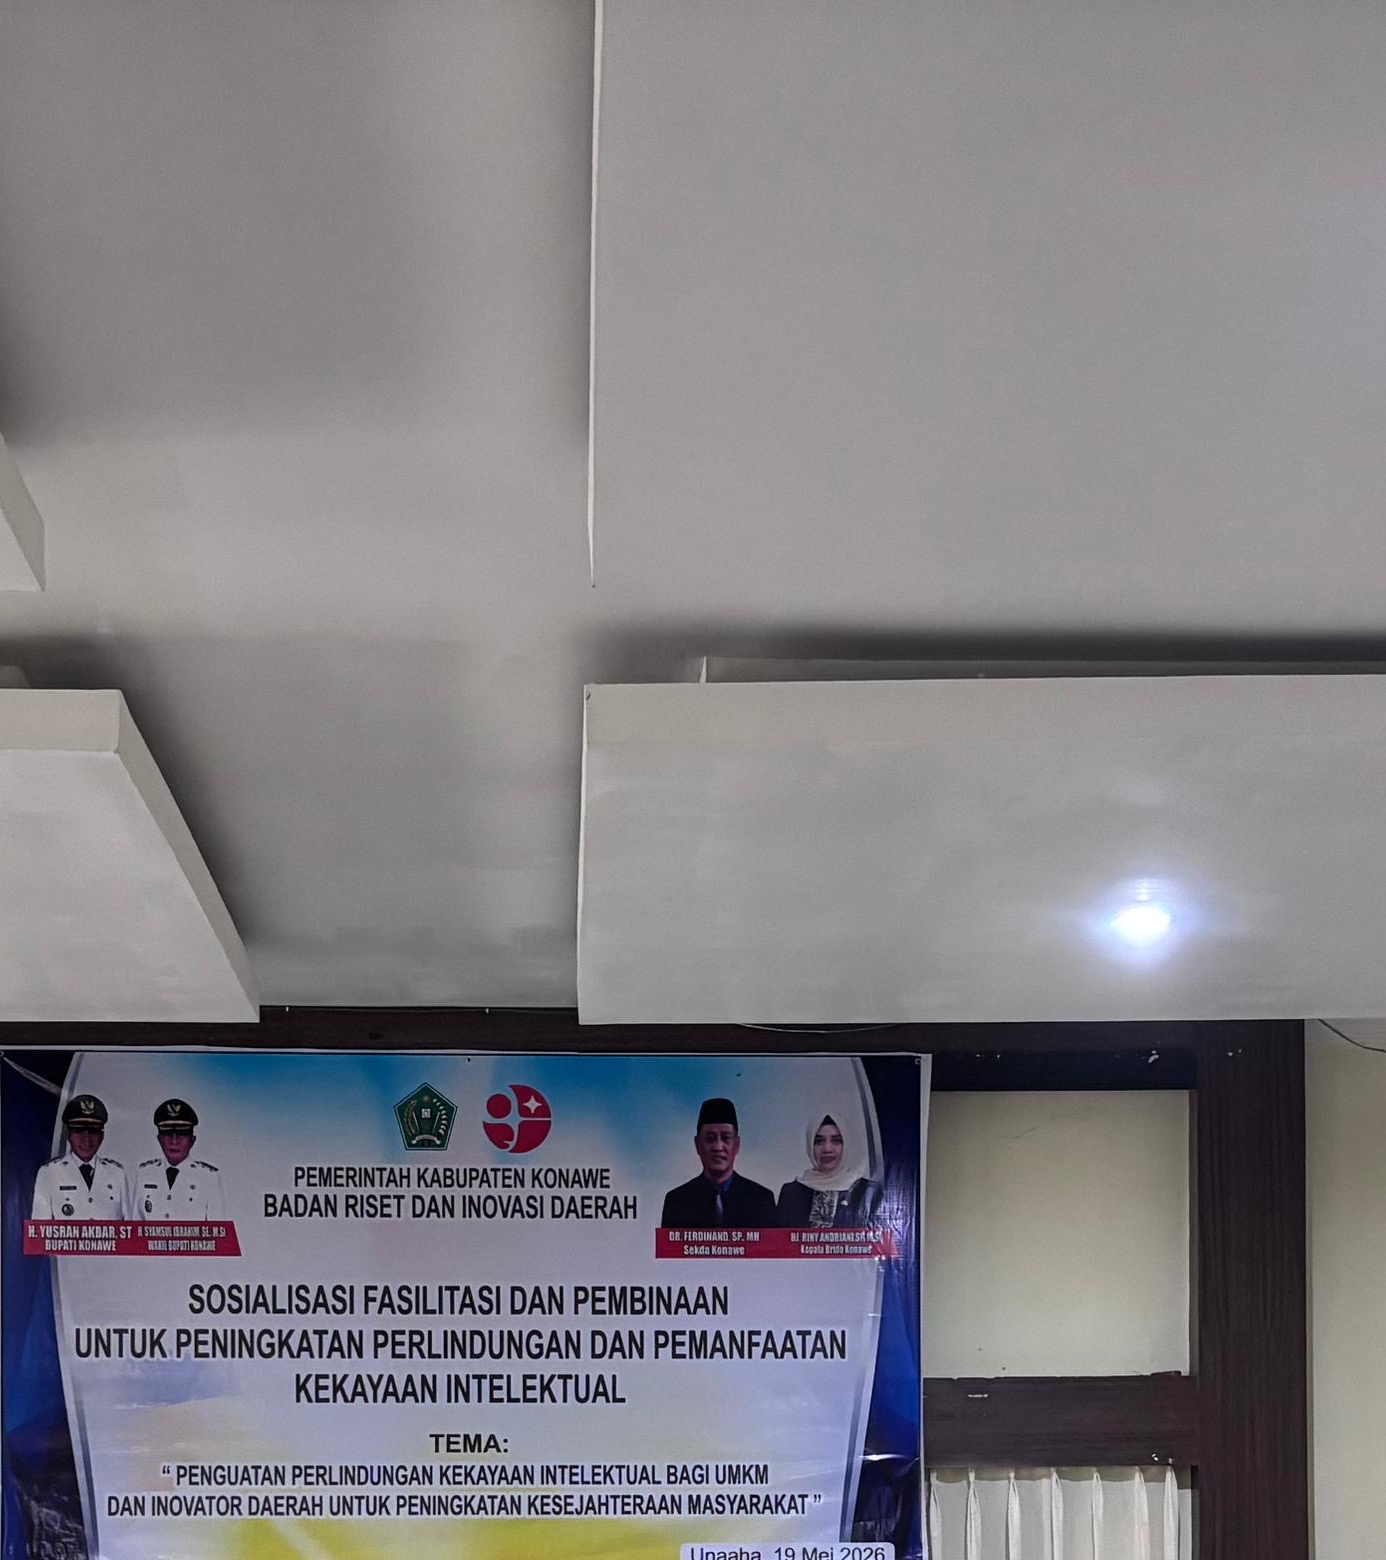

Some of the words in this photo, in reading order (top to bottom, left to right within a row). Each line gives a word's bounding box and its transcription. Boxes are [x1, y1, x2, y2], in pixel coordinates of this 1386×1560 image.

[295, 1167, 410, 1188] PEMERINTAH
[417, 1167, 524, 1188] KABUPATEN
[531, 1167, 611, 1189] KONAWE
[264, 1194, 337, 1218] BADAN
[345, 1194, 405, 1218] RISET
[412, 1195, 454, 1218] DAN
[462, 1195, 544, 1219] INOVASI
[551, 1195, 637, 1219] DAERAH
[40, 1225, 80, 1239] YUSRAN
[81, 1226, 118, 1240] AKBAR,
[120, 1226, 133, 1239] ST
[746, 1231, 760, 1242] MH
[45, 1239, 77, 1251] BUPATI
[78, 1239, 117, 1251] KONAWE
[168, 1240, 190, 1251] BUPATI
[683, 1245, 710, 1255] Sekda
[711, 1245, 745, 1255] Konawe
[188, 1284, 355, 1315] SOSIALISASI
[364, 1285, 501, 1315] FASILITASI
[511, 1286, 563, 1315] DAN
[574, 1286, 728, 1315] PEMBINAAN
[76, 1328, 168, 1359] UNTUK
[177, 1329, 364, 1359] PENINGKATAN
[373, 1329, 580, 1359] PERLINDUNGAN
[590, 1330, 644, 1359] DAN
[654, 1330, 846, 1360] PEMANFAATAN
[296, 1374, 436, 1404] KEKAYAAN
[446, 1374, 626, 1404] INTELEKTUAL
[429, 1433, 509, 1454] TEMA:
[176, 1465, 285, 1485] PENGUATAN
[291, 1465, 433, 1485] PERLINDUNGAN
[439, 1465, 534, 1485] KEKAYAAN
[540, 1465, 661, 1485] INTELEKTUAL
[666, 1464, 710, 1485] BAGI
[715, 1464, 769, 1484] UMKM
[108, 1496, 145, 1516] DAN
[151, 1496, 243, 1516] INOVATOR
[248, 1496, 323, 1516] DAERAH
[329, 1496, 391, 1516] UNTUK
[396, 1495, 521, 1516] PENINGKATAN
[527, 1494, 681, 1515] KESEJAHTERAAN
[687, 1494, 809, 1515] MASYARAKAT
